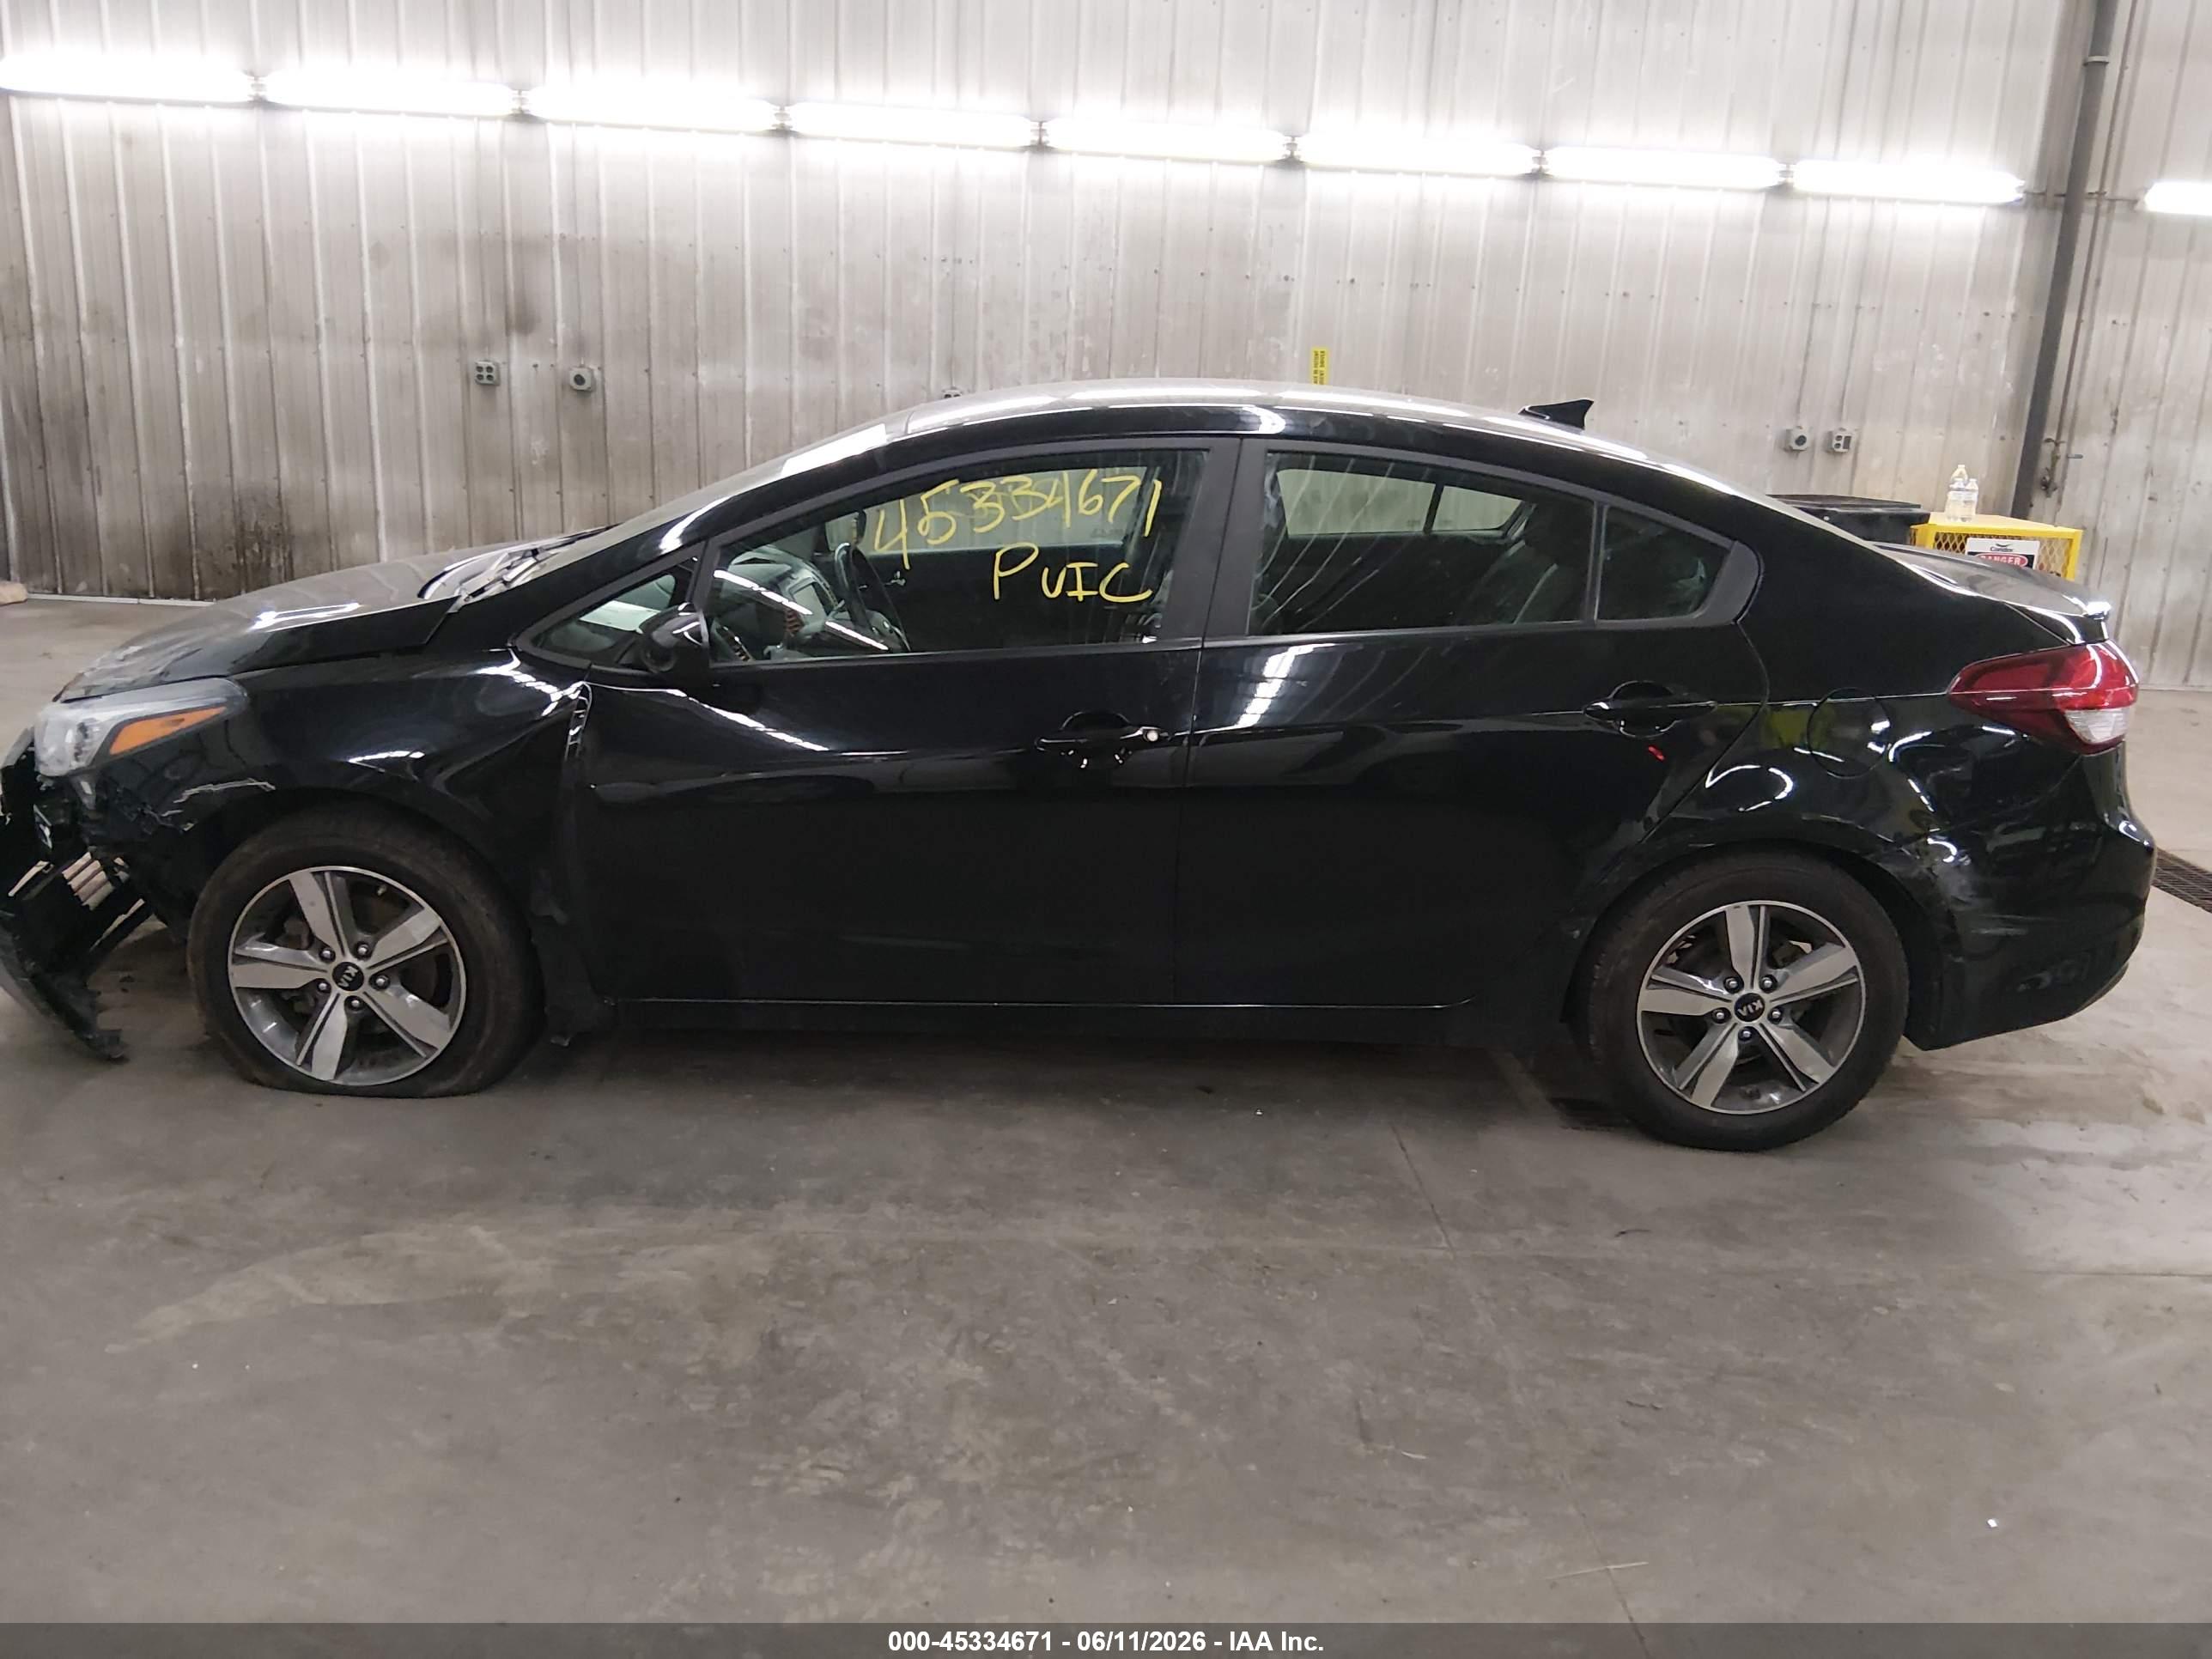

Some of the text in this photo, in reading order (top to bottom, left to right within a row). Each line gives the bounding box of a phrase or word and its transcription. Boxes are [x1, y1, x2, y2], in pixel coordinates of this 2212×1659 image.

[874, 470, 1163, 569] 45334671
[337, 965, 358, 988] KIA
[1737, 999, 1764, 1016] KIA
